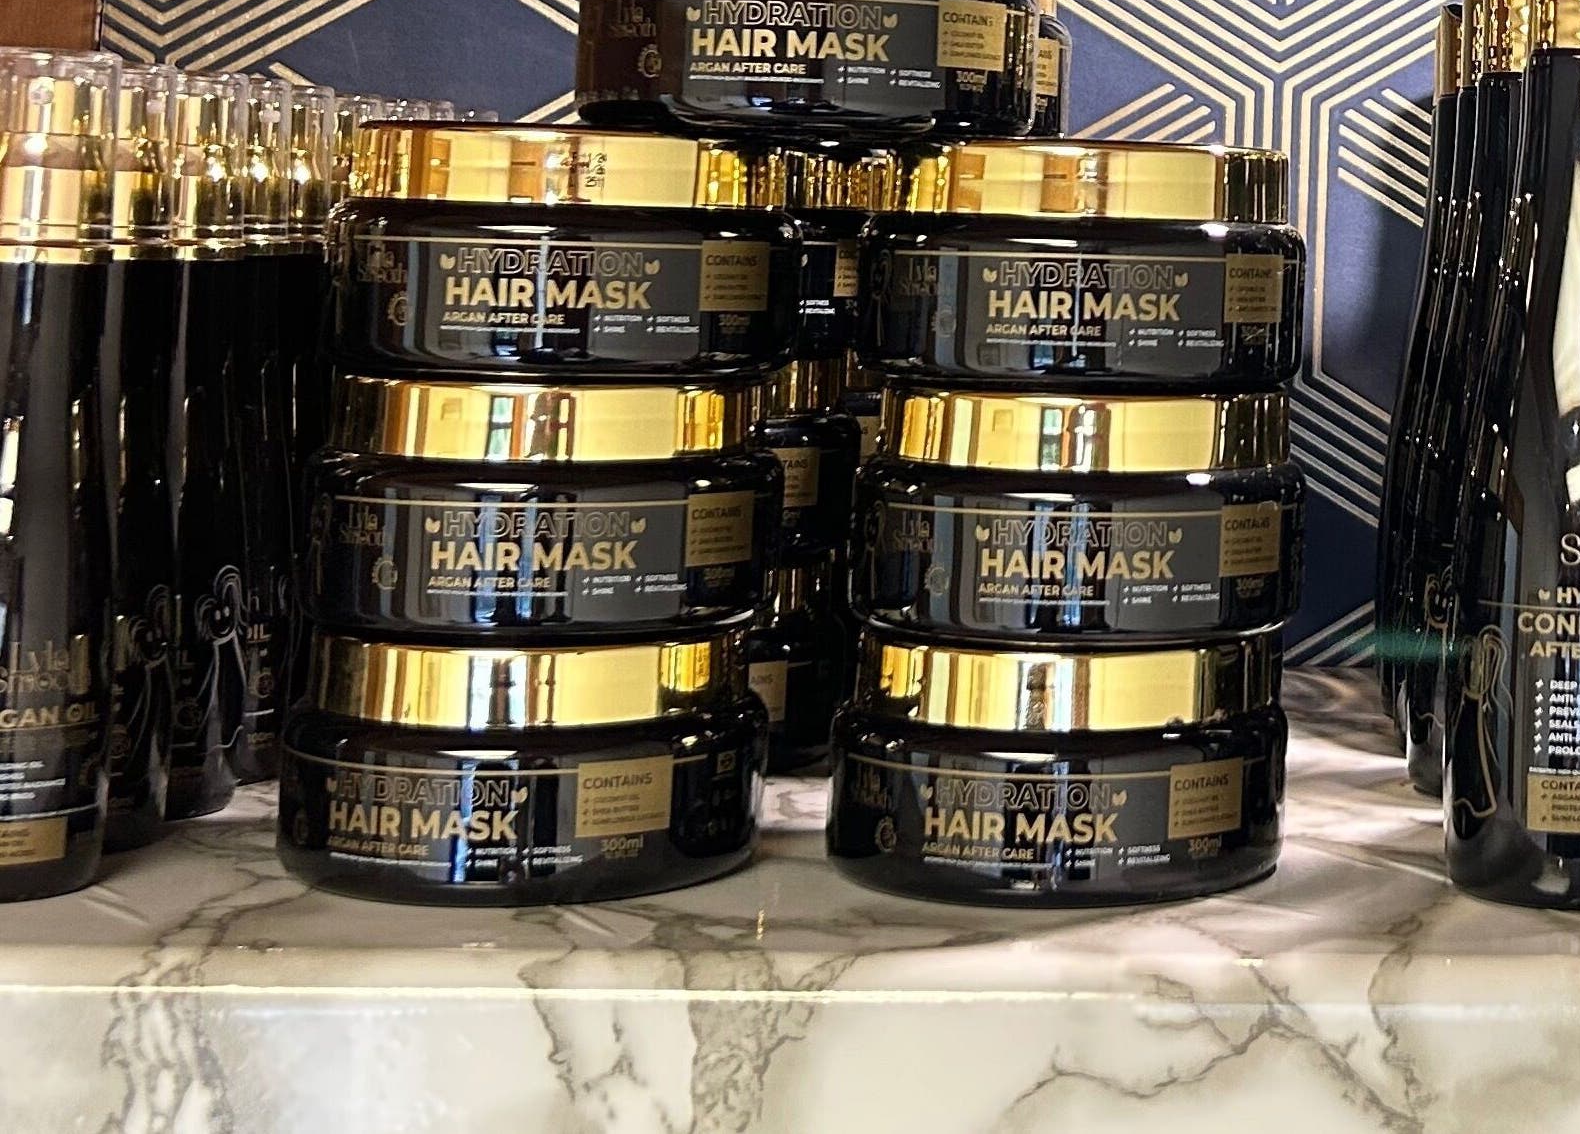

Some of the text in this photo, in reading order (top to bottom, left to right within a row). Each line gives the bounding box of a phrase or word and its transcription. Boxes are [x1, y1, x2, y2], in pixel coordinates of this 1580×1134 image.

[702, 0, 882, 30] HYDRATION
[691, 28, 890, 62] HAIR MASK
[689, 62, 807, 75] ARGAN AFTER CARE
[457, 247, 645, 278] HYDRATION
[1000, 262, 1173, 289] HYDRATION
[445, 276, 652, 311] HAIR MASK
[988, 290, 1181, 322] HAIR MASK
[443, 312, 566, 326] ARGAN AFTER CARE
[986, 324, 1102, 337] ARGAN AFTER CARE
[443, 511, 630, 538] HYDRATION
[992, 519, 1168, 548] HYDRATION
[431, 540, 638, 571] HAIR MASK
[980, 548, 1175, 580] HAIR MASK
[428, 576, 551, 589] ARGAN AFTER CARE
[978, 583, 1095, 597] ARGAN AFTER CARE
[1550, 680, 1577, 691] DEEP
[1549, 719, 1580, 730] SEALS
[336, 770, 509, 808] HYDRATION
[582, 772, 653, 790] CONTAINS
[1174, 774, 1229, 791] CONTAINS
[936, 780, 1111, 811] HYDRATION
[328, 800, 518, 842] HAIR MASK
[924, 807, 1119, 844] HAIR MASK
[601, 833, 644, 852] 300ml
